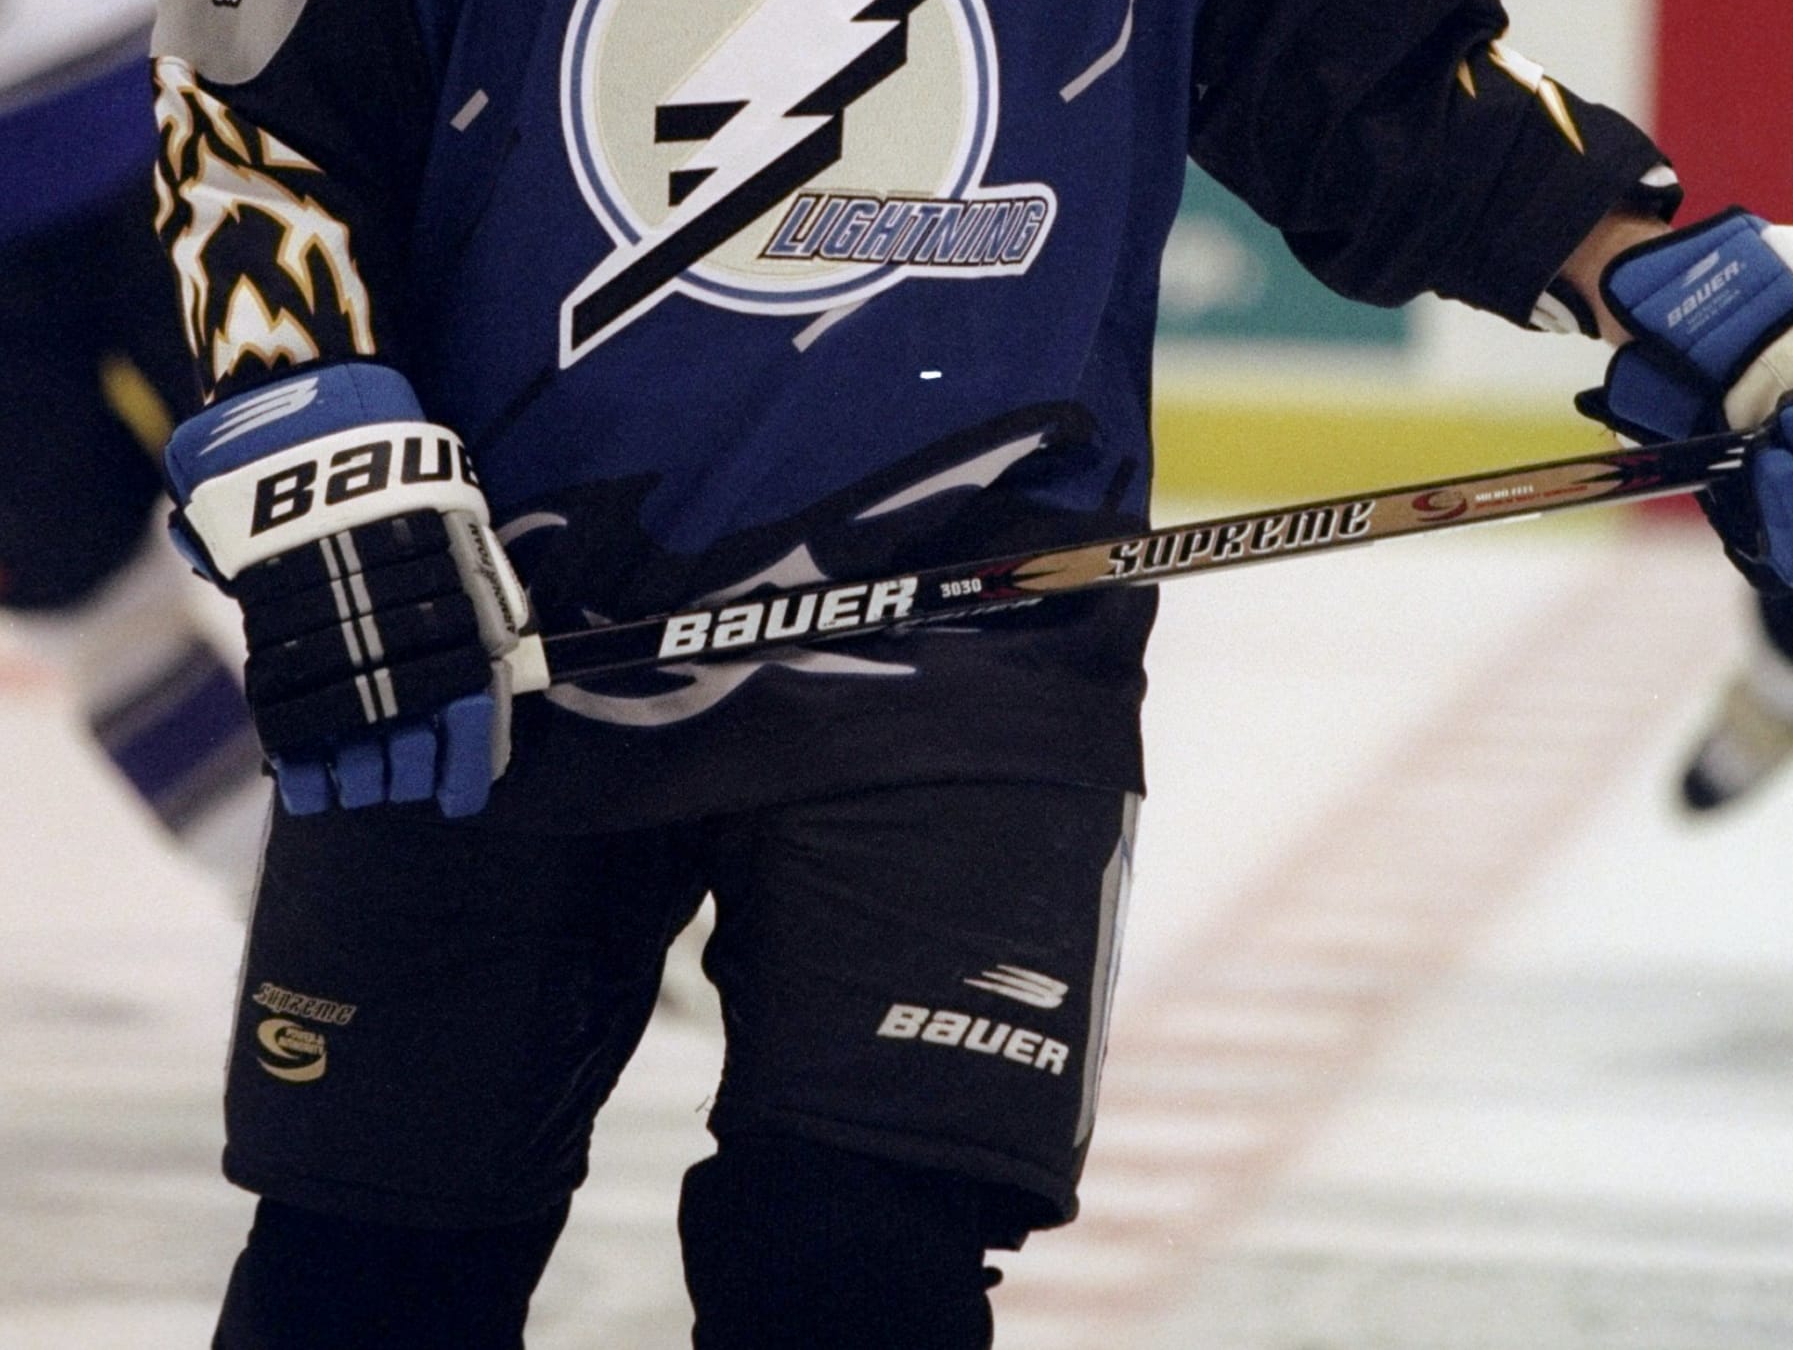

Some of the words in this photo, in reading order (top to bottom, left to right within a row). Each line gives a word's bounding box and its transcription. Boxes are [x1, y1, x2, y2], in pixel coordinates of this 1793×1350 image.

[758, 192, 1048, 268] LIGHTNING
[1667, 260, 1740, 329] BAUER
[1094, 500, 1376, 581] SUPREME
[658, 576, 918, 659] BAUER
[940, 578, 982, 598] 3030
[876, 1004, 1070, 1076] BAUER
